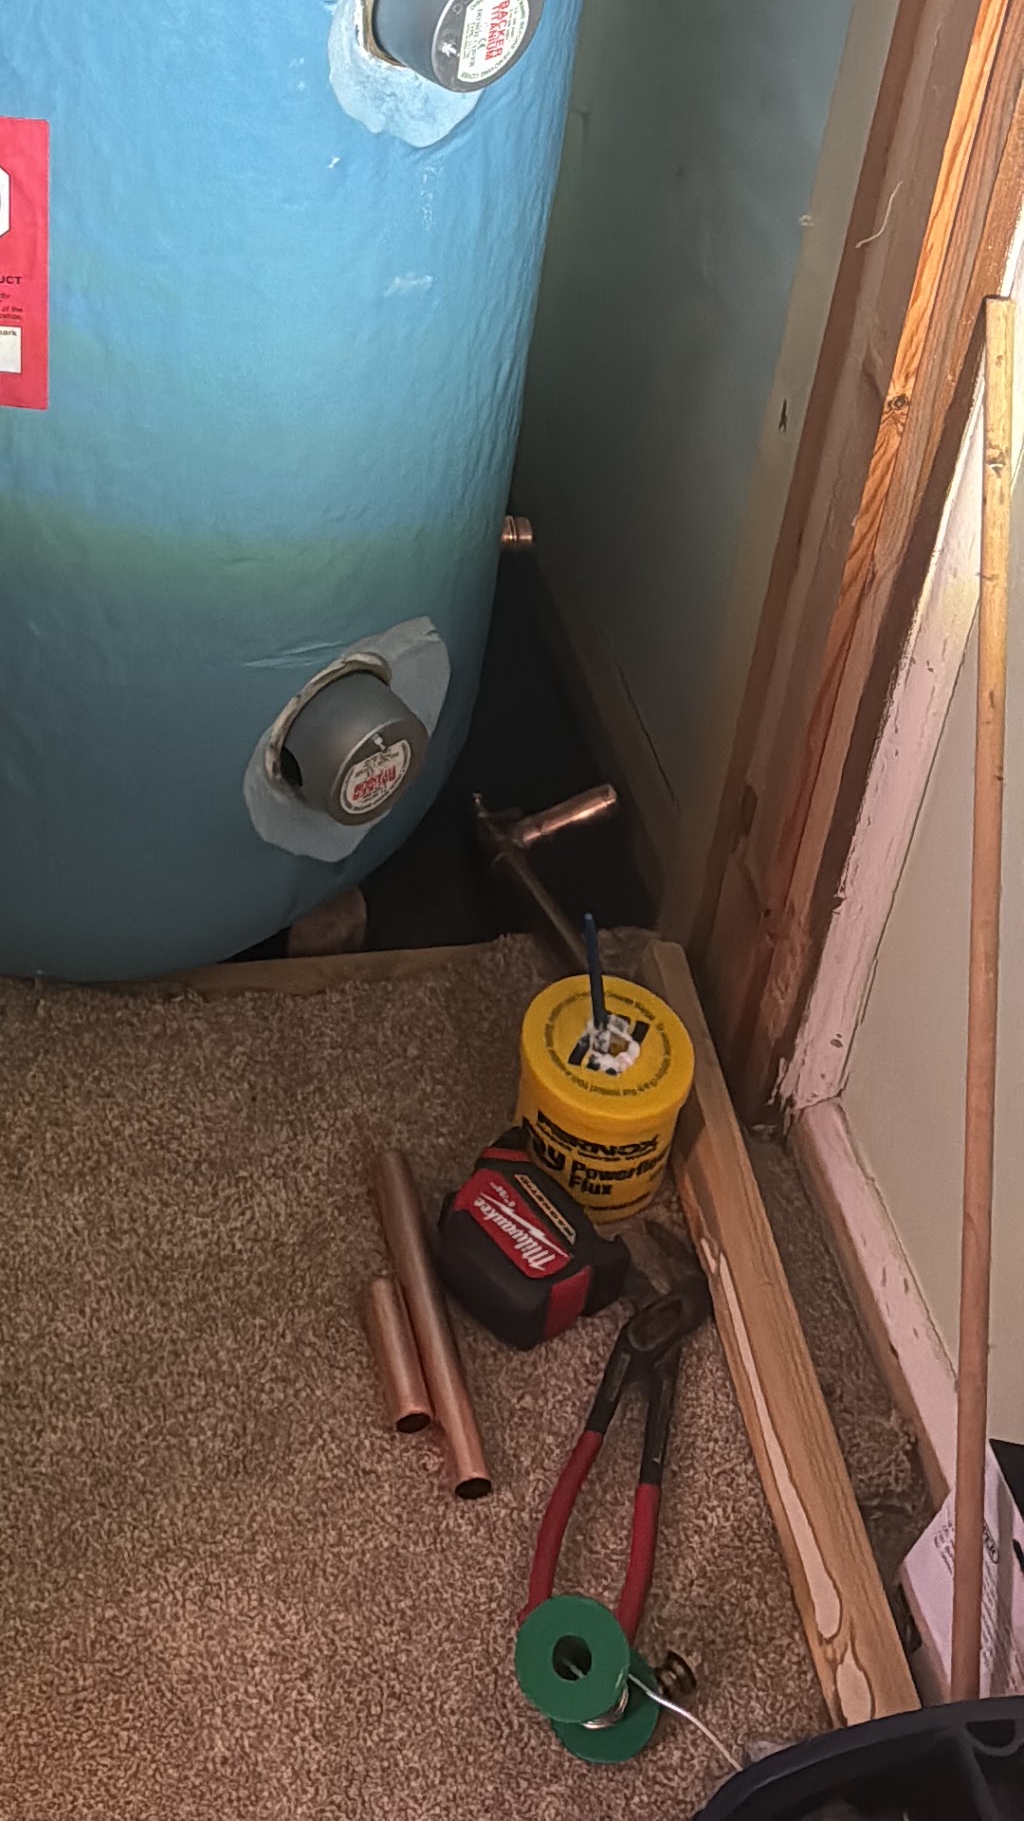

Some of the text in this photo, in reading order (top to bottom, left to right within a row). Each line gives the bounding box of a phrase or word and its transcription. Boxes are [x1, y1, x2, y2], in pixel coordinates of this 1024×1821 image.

[494, 0, 511, 57] BACKER
[569, 1175, 613, 1196] Flux
[474, 1197, 556, 1271] Milwaukee
